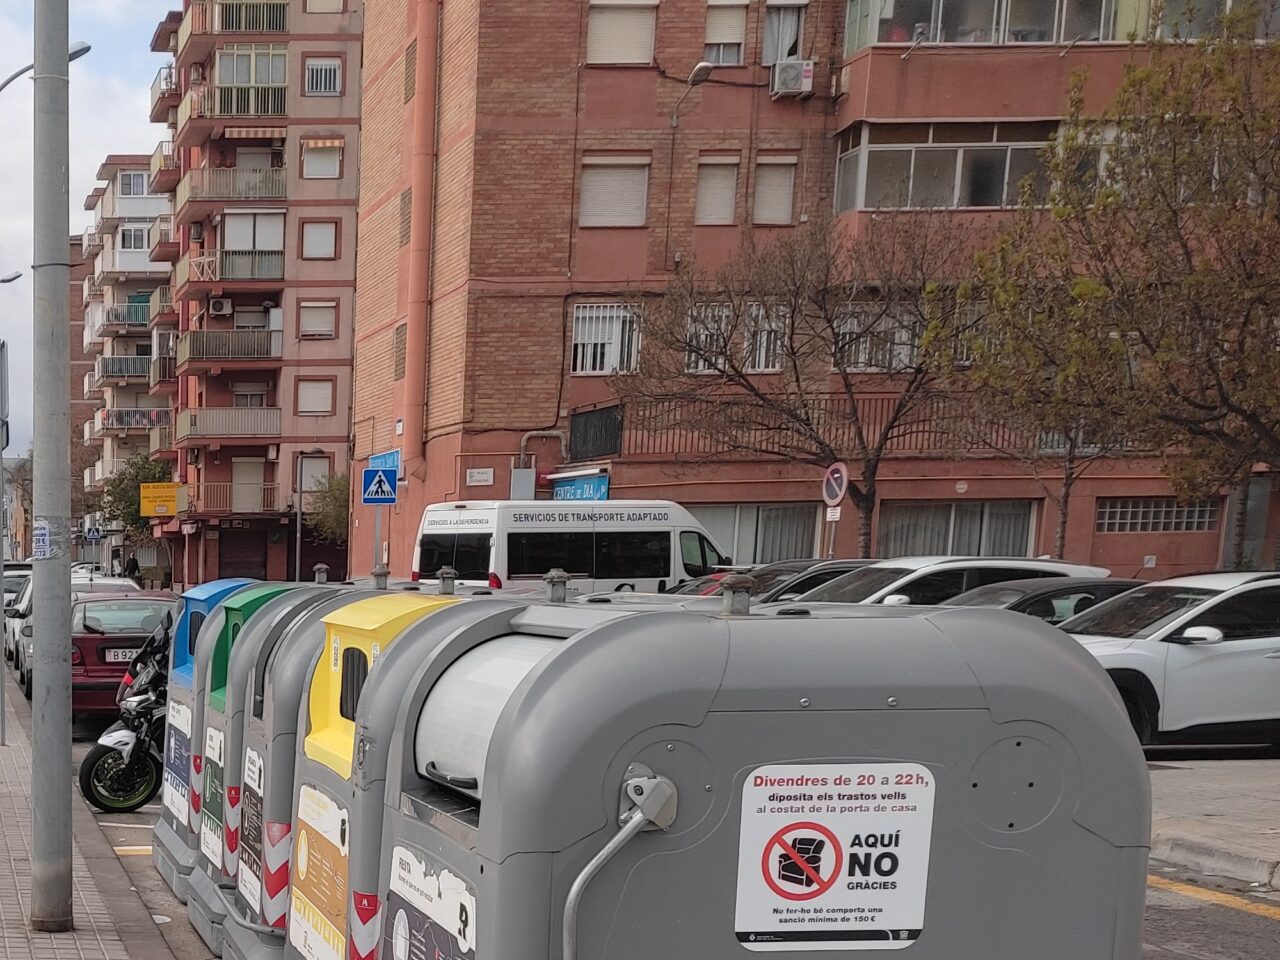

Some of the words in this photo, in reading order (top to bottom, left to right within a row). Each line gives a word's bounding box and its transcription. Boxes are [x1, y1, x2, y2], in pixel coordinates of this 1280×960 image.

[553, 486, 575, 500] CENTRE
[576, 489, 582, 498] DE
[512, 512, 556, 522] SERVICIOS
[558, 513, 569, 522] DE
[570, 512, 625, 522] TRANSPORTE
[626, 512, 669, 522] ADAPTADO
[113, 650, 120, 660] B
[121, 650, 139, 660] 92
[753, 775, 828, 787] Divendres
[833, 775, 851, 786] de
[856, 774, 876, 786] 20
[880, 776, 889, 786] a
[768, 792, 814, 802] diposita
[817, 792, 834, 801] els
[837, 792, 877, 800] trastos
[880, 792, 907, 800] vells
[756, 804, 766, 813] al
[770, 804, 805, 813] costat
[808, 804, 823, 813] de
[826, 804, 836, 813] la
[840, 804, 870, 814] porta
[873, 804, 888, 812] de
[891, 804, 917, 812] casa
[850, 830, 901, 848] AQUÍ
[847, 852, 899, 877] NO
[847, 880, 897, 890] GRÀCIES
[773, 907, 784, 915] No
[813, 906, 823, 914] bé
[826, 906, 866, 915] comporta
[778, 915, 806, 923] sanció
[808, 915, 838, 923] mínima
[840, 915, 851, 923] de
